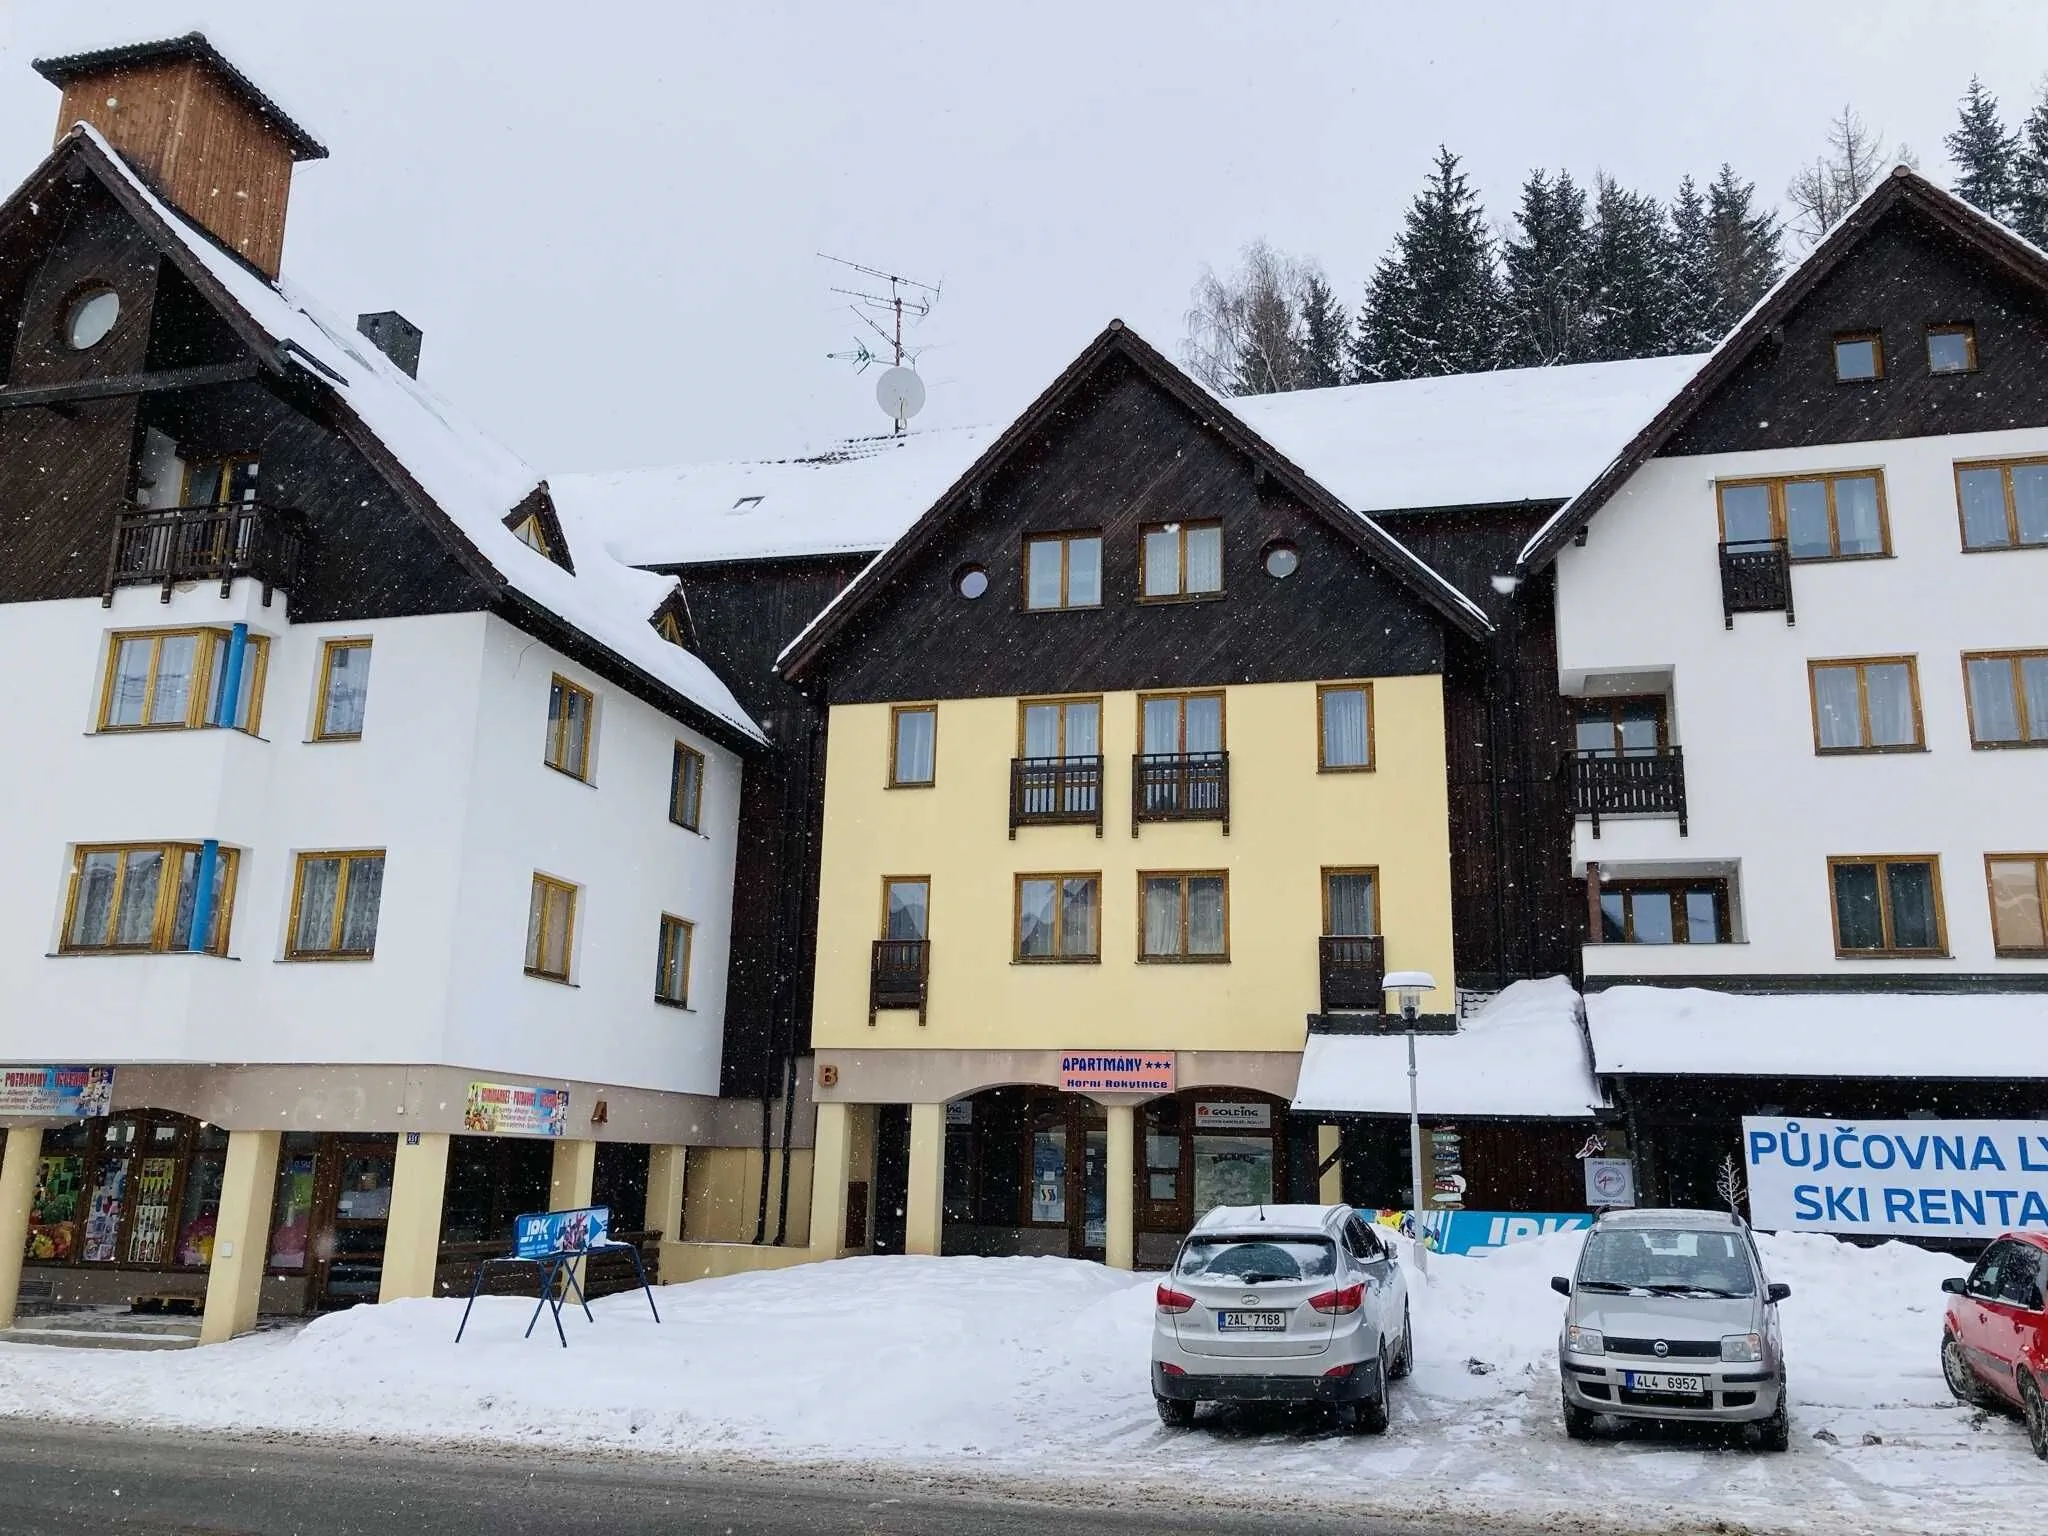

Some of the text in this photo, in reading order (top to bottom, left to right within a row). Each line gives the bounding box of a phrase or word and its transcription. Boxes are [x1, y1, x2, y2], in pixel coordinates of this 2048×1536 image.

[1062, 1055, 1142, 1072] APARTMÁNY
[819, 1064, 838, 1087] B
[591, 1101, 608, 1123] A
[1750, 1121, 2006, 1172] PŮJČOVNA
[1794, 1185, 2048, 1227] SKI RENTA
[1227, 1313, 1280, 1326] 2AL 7168
[1637, 1375, 1697, 1390] 4L4 6952
